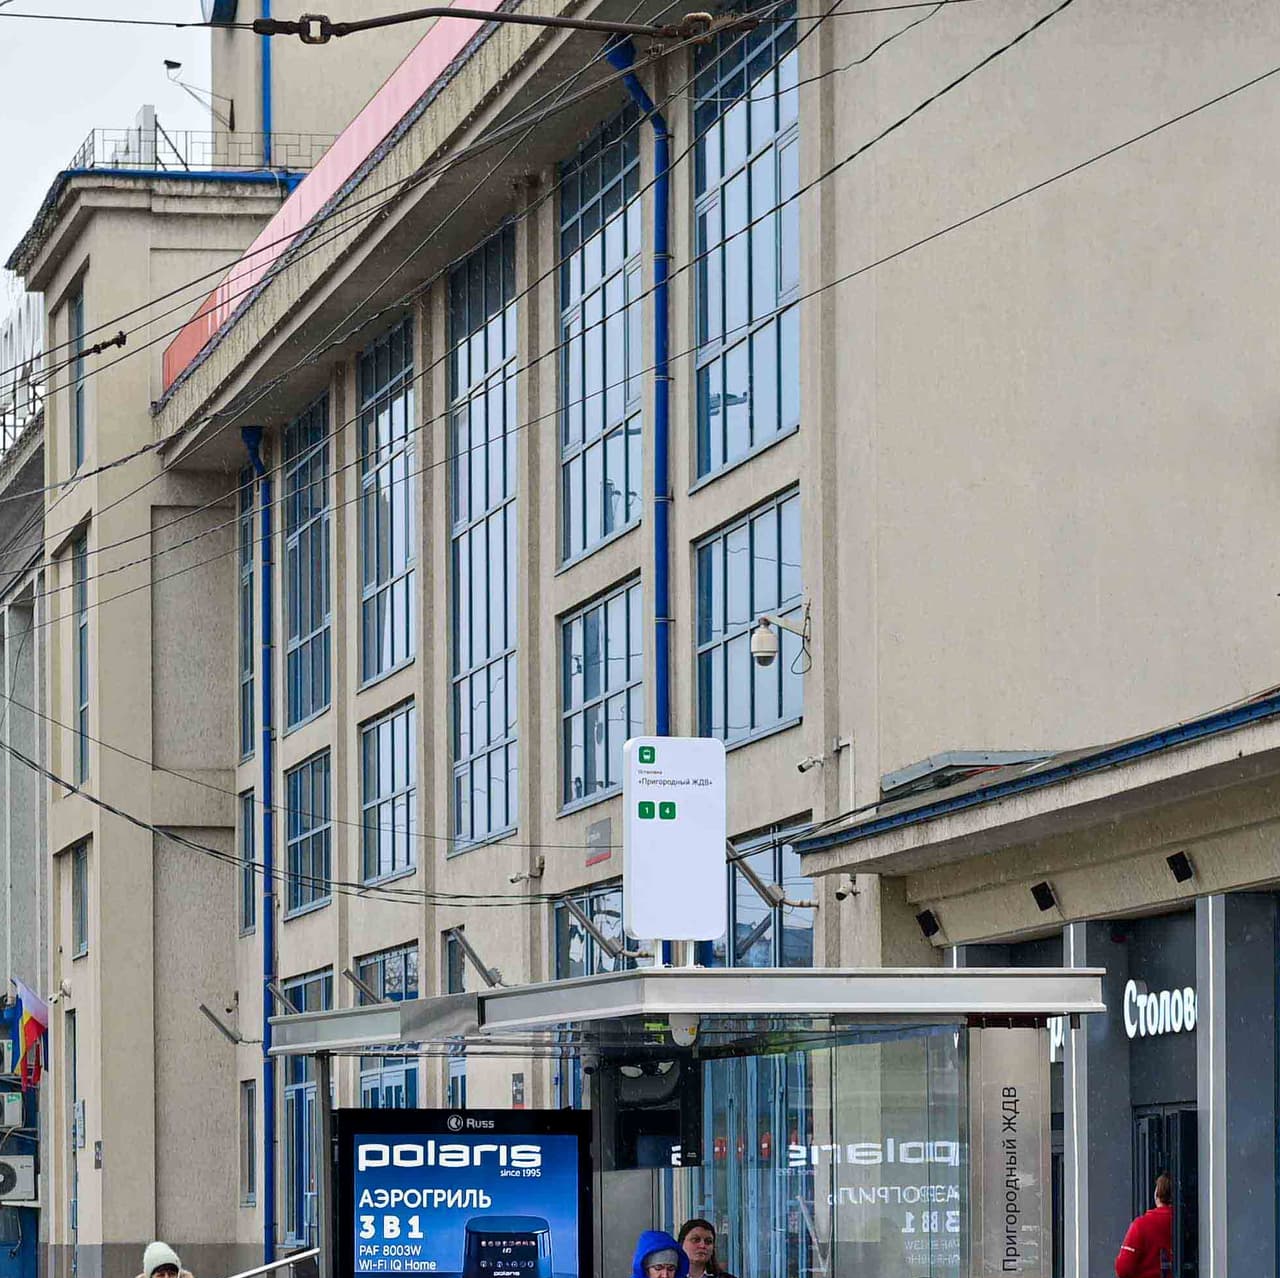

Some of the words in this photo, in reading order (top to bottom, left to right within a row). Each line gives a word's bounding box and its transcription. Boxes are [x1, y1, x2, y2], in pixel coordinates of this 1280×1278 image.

[1123, 978, 1197, 1039] Столов
[1001, 1085, 1020, 1133] ЖДВ
[466, 1118, 495, 1129] Russ
[357, 1139, 542, 1172] polaris
[500, 1169, 521, 1177] since
[522, 1169, 542, 1177] 1995
[358, 1188, 492, 1209] АЭРОГРИЛЬ
[1002, 1139, 1021, 1272] Пригородный
[359, 1215, 376, 1240] 3
[407, 1215, 424, 1239] 1
[359, 1245, 380, 1256] PAF
[382, 1244, 422, 1256] 8003W
[404, 1259, 437, 1270] Home
